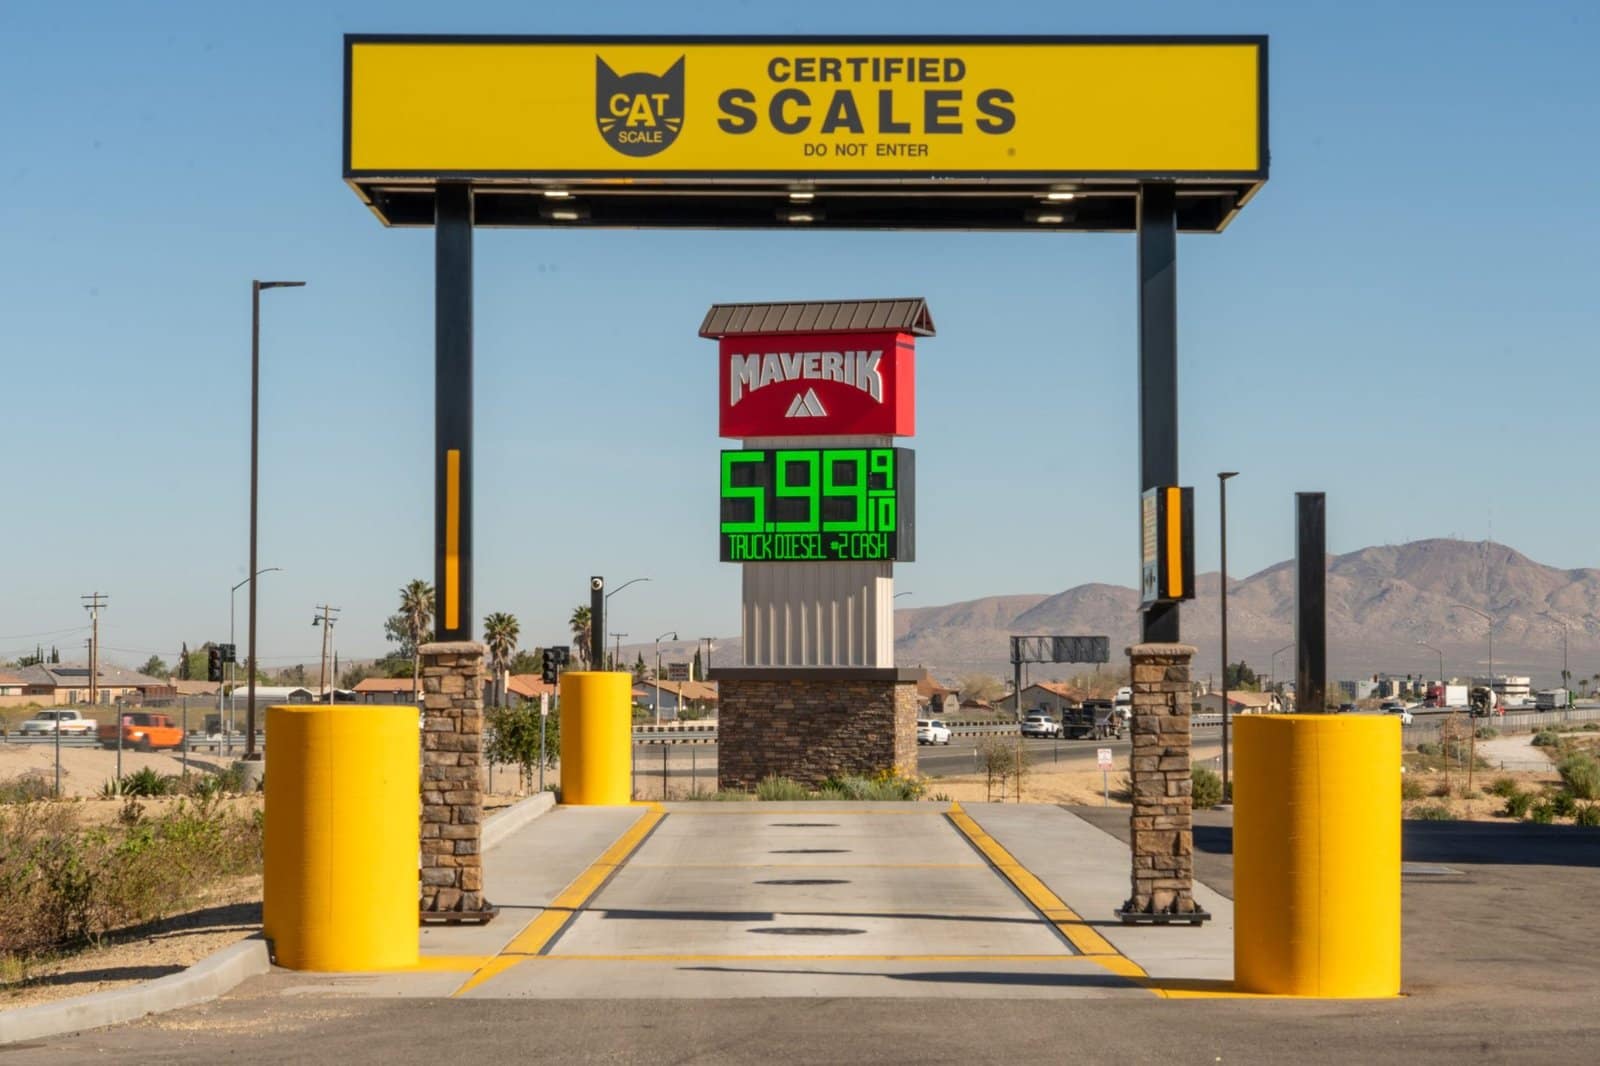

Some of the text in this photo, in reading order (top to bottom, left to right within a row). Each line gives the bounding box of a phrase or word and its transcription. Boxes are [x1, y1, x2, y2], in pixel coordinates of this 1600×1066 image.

[767, 57, 966, 82] CERTIFIED
[609, 93, 670, 127] CAT
[717, 88, 1017, 135] SCALES
[618, 131, 663, 144] SCALE
[803, 143, 929, 157] DO NOT ENTER
[730, 350, 884, 407] MAVERIK
[721, 450, 867, 533] 5.99
[729, 534, 772, 559] TRUCK
[775, 534, 827, 559] DIESEL
[851, 533, 888, 558] CASH
